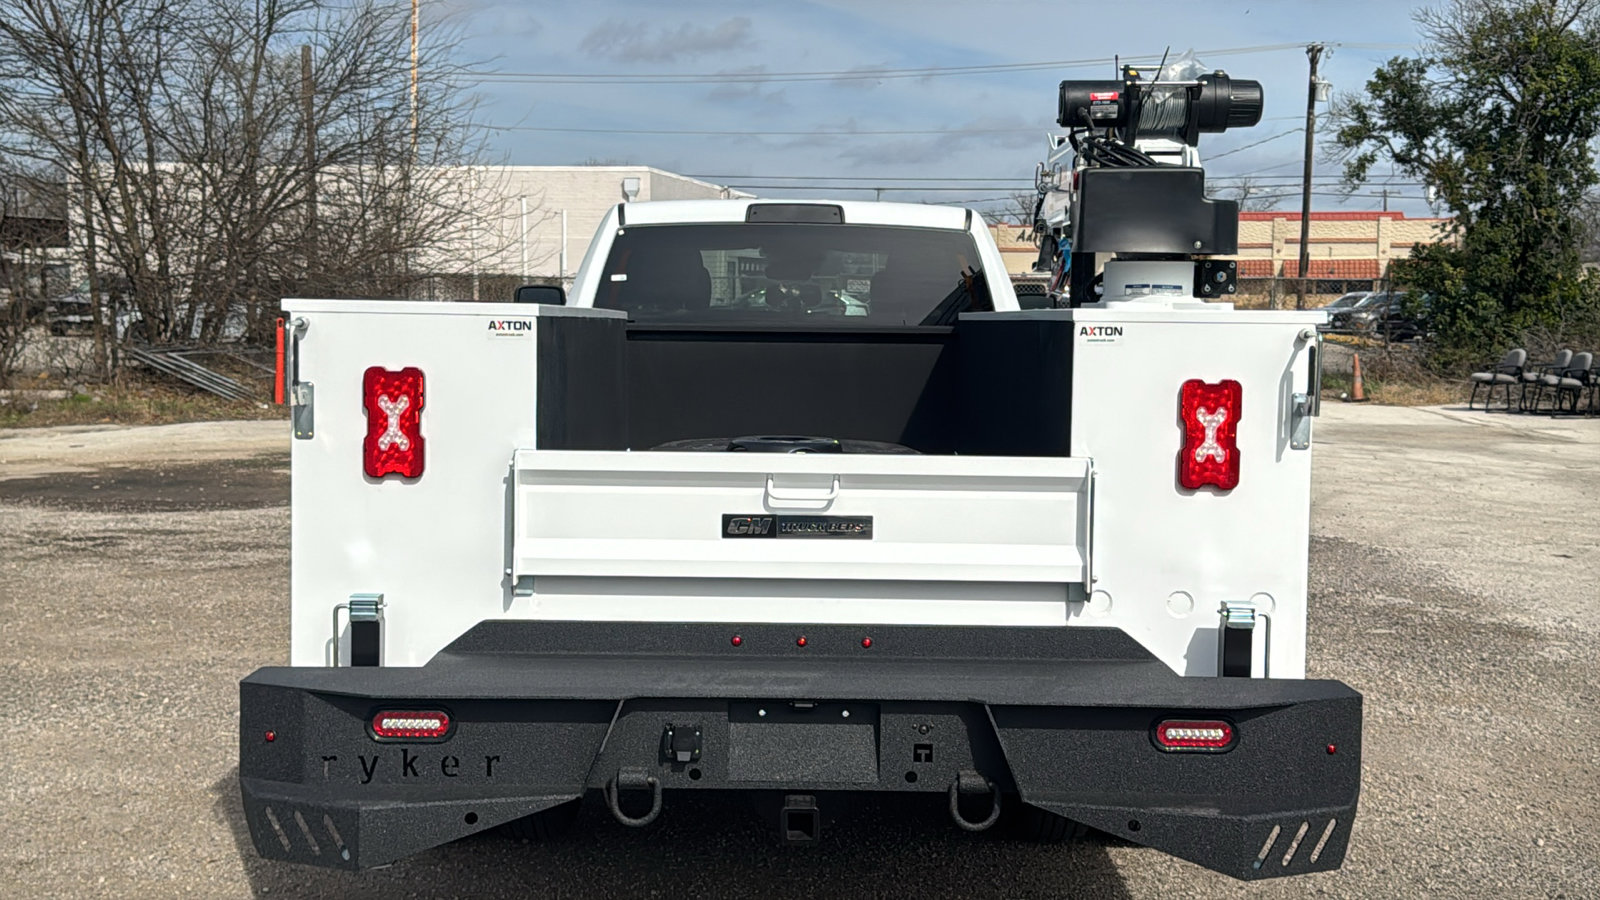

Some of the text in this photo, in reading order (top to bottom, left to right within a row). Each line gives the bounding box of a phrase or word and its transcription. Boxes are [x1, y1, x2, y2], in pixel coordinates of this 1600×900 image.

[488, 320, 532, 331] AXTON
[1080, 326, 1123, 337] AXTON
[781, 521, 826, 533] TRUCK
[827, 521, 864, 533] BEDS
[321, 748, 500, 785] ryker
